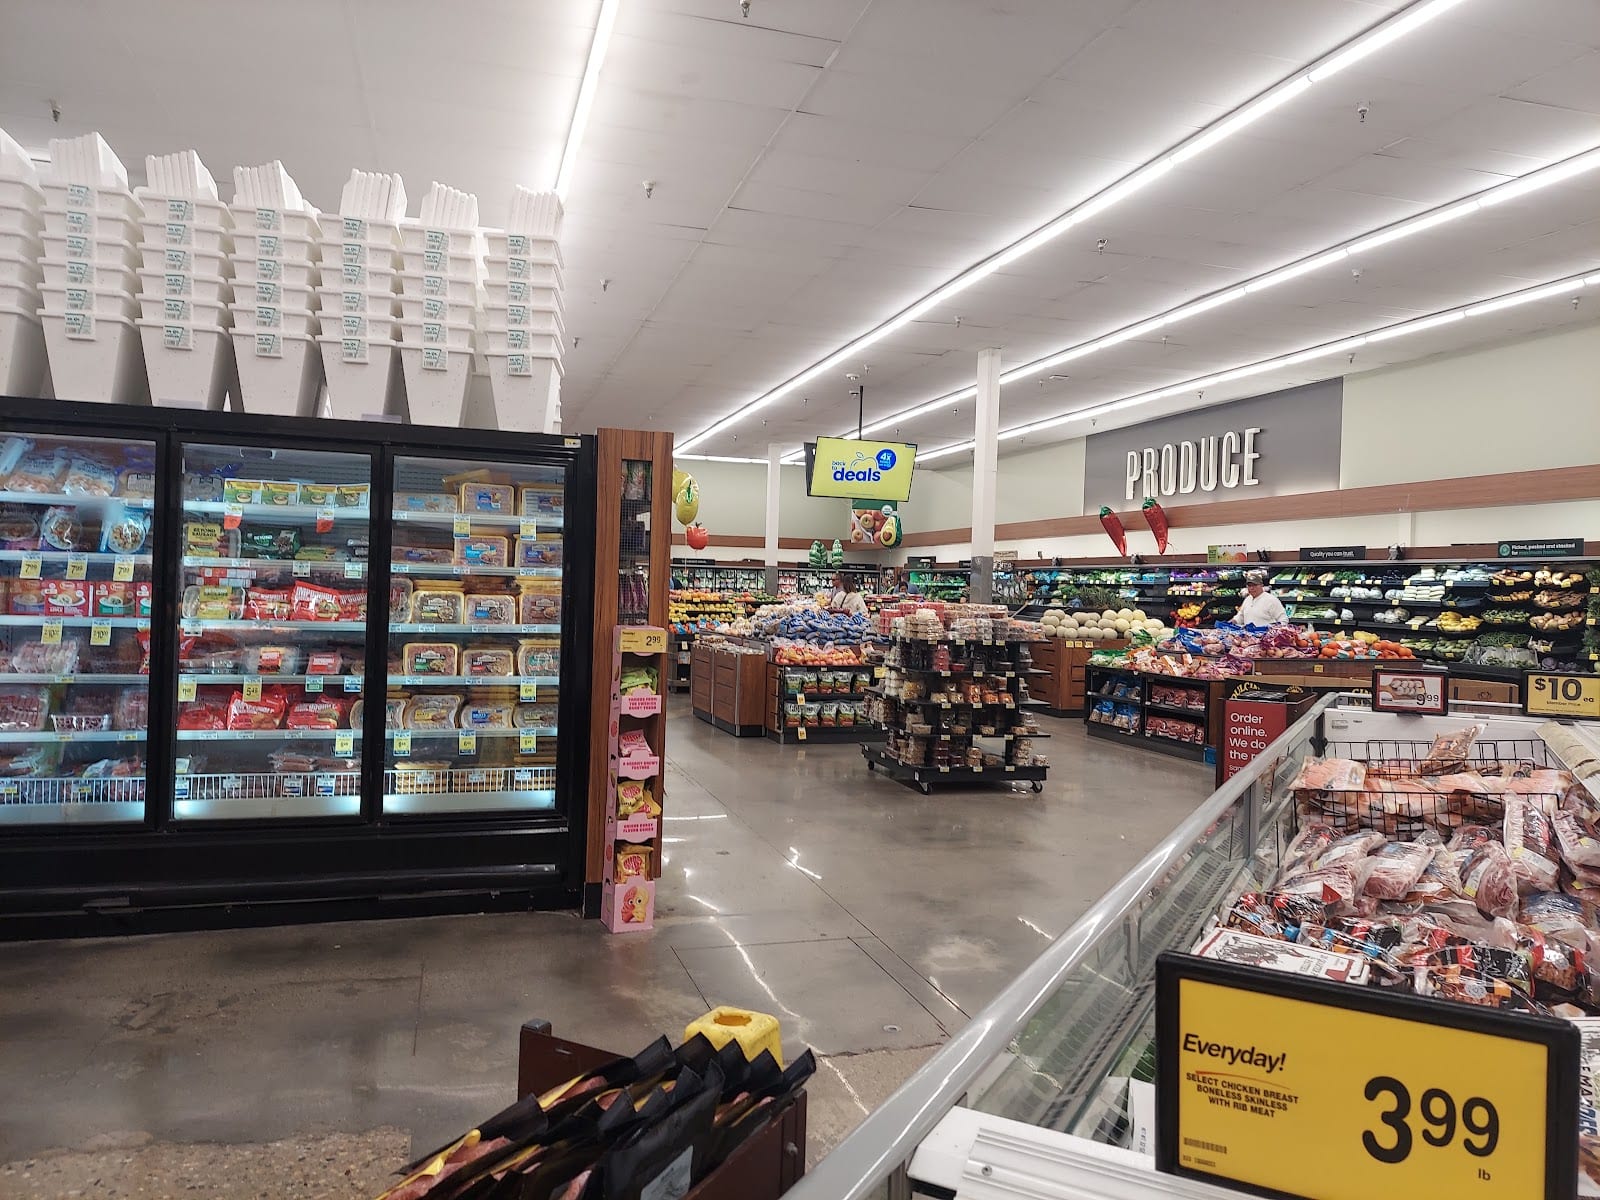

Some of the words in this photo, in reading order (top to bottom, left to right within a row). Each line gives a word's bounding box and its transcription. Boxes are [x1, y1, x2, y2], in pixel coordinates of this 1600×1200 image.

[1125, 427, 1262, 500] PRODUCE
[833, 467, 881, 482] deals
[1534, 676, 1582, 701] $10
[1230, 712, 1264, 724] Order
[1230, 725, 1267, 737] online.
[1229, 737, 1248, 748] We
[1250, 739, 1266, 749] do
[1229, 750, 1248, 761] the
[1182, 1032, 1287, 1073] Everyday!
[1186, 1072, 1219, 1087] SELECT
[1221, 1080, 1261, 1095] CHICKEN
[1263, 1089, 1299, 1104] BREAST
[1196, 1085, 1243, 1101] BONELESS
[1245, 1095, 1288, 1111] SKINLESS
[1208, 1096, 1231, 1108] WITH
[1233, 1102, 1248, 1112] RIB
[1250, 1106, 1275, 1118] MEAT
[1477, 1168, 1491, 1182] lb
